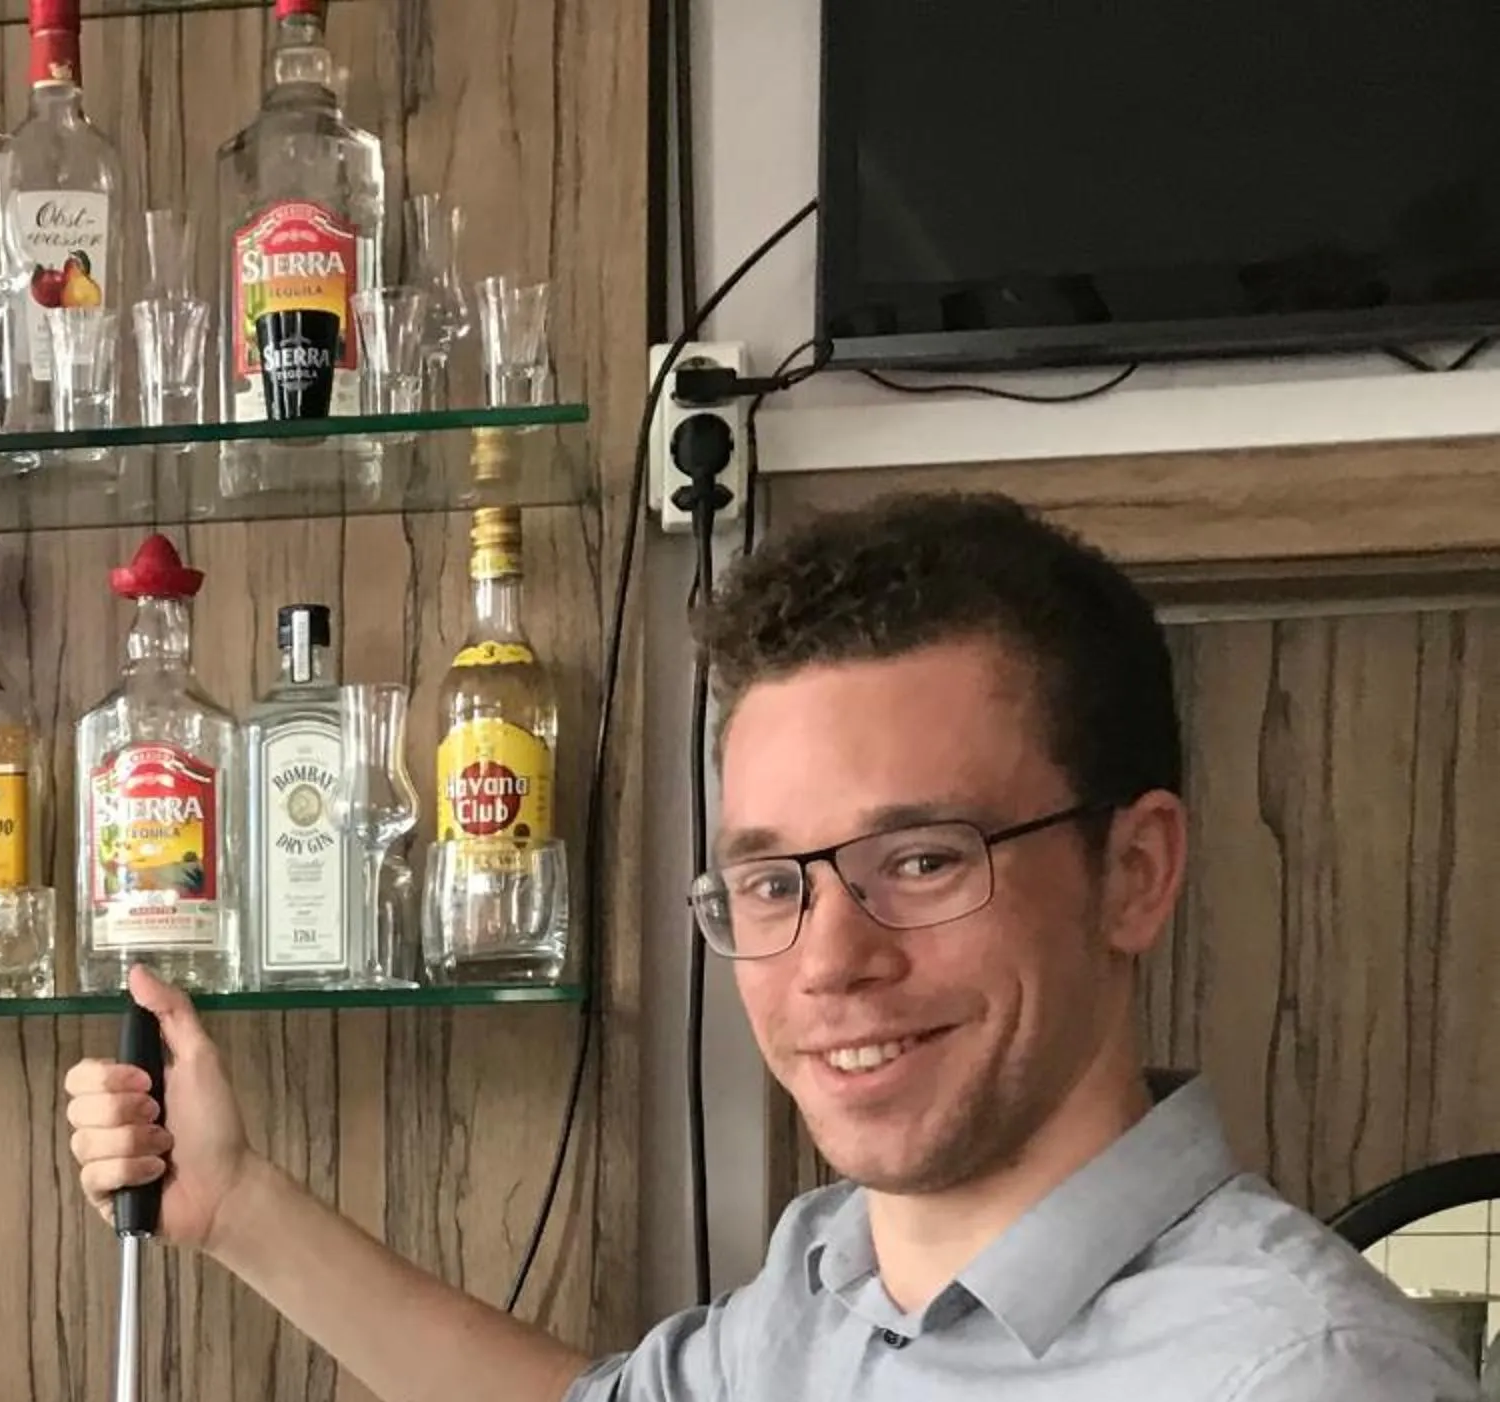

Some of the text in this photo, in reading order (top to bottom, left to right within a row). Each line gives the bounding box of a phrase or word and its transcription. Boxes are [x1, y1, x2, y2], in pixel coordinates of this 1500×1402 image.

[242, 249, 347, 284] SIERRA
[263, 342, 331, 371] SIERRA
[447, 774, 529, 798] Havana
[96, 795, 204, 828] SIERRA
[456, 800, 509, 824] Club
[276, 833, 334, 855] DRY GIN
